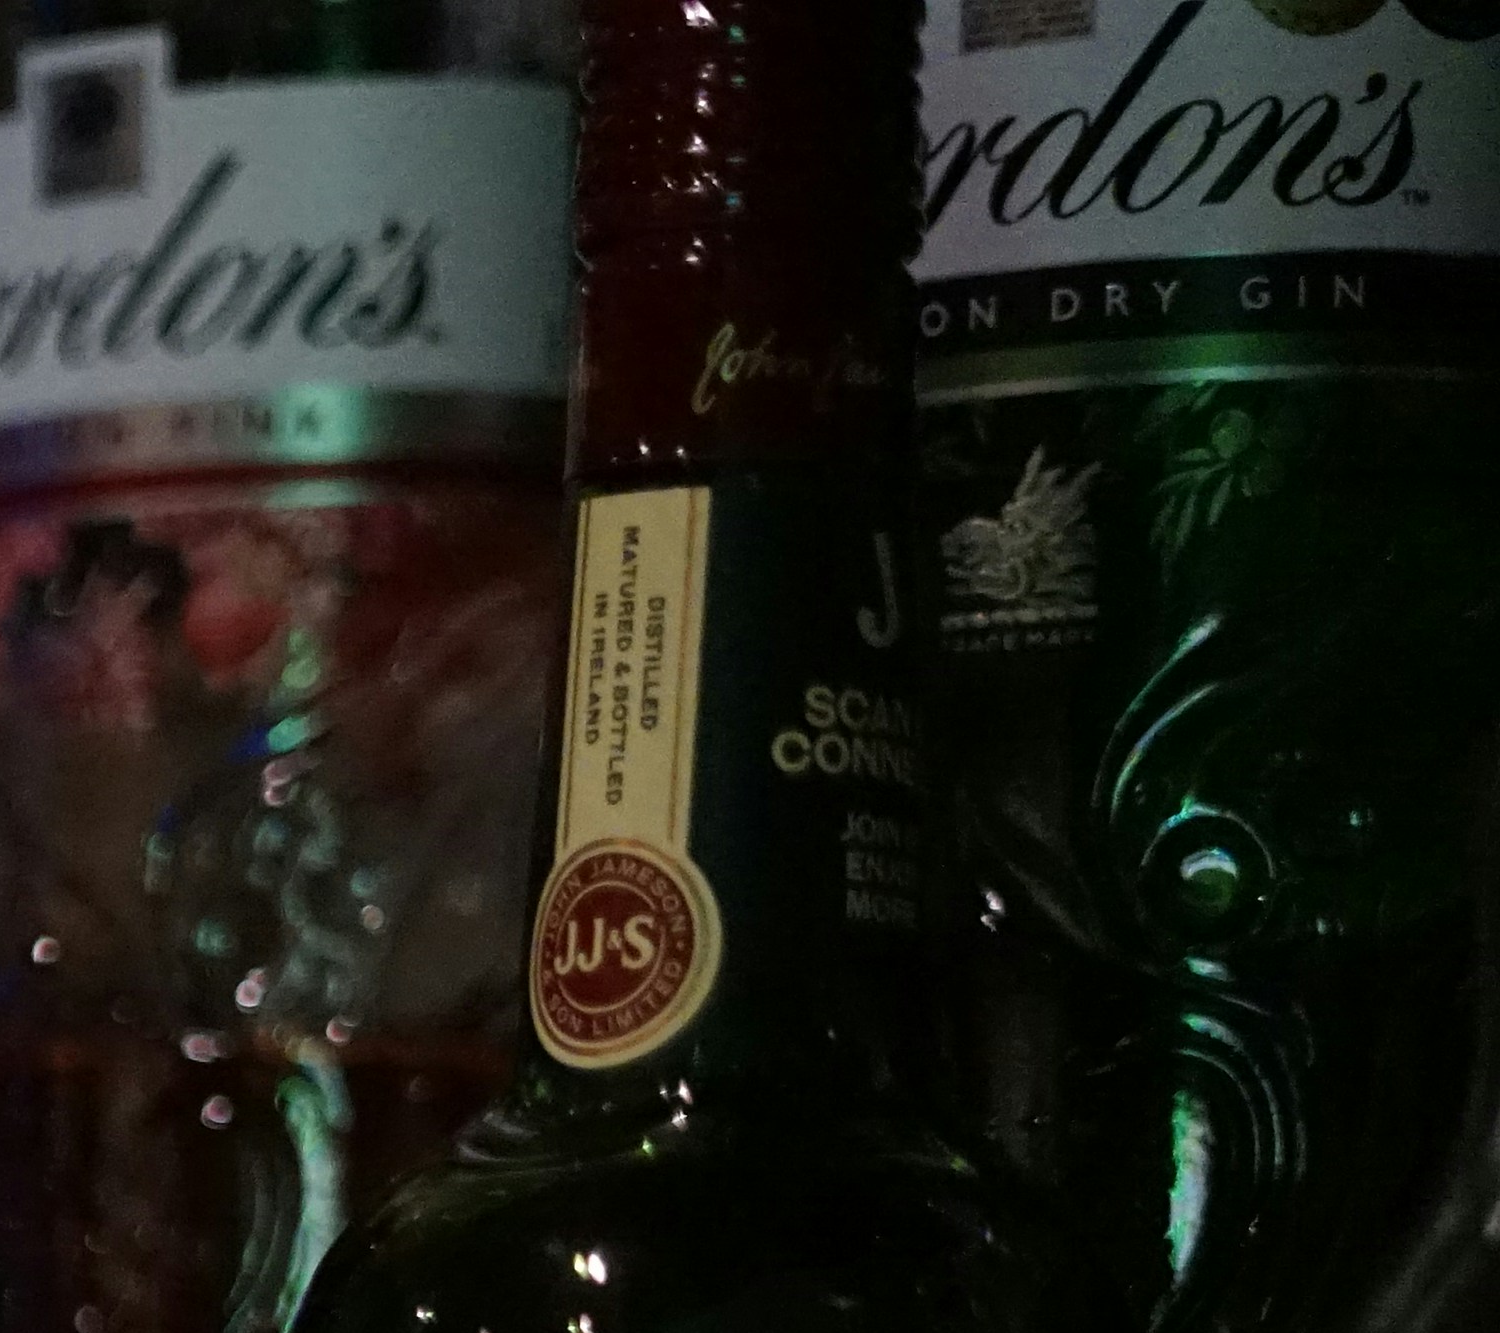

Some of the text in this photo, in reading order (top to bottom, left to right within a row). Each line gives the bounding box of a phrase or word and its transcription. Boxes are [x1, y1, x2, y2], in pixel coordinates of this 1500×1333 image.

[1050, 279, 1181, 323] DRY
[1239, 274, 1366, 312] GIN
[585, 592, 609, 745] IN IRELAND
[604, 524, 641, 806] MATURED & BOTTLED
[639, 596, 666, 731] DISTILLED
[590, 858, 688, 934] JAMESON
[591, 958, 684, 1037] LIMITED
